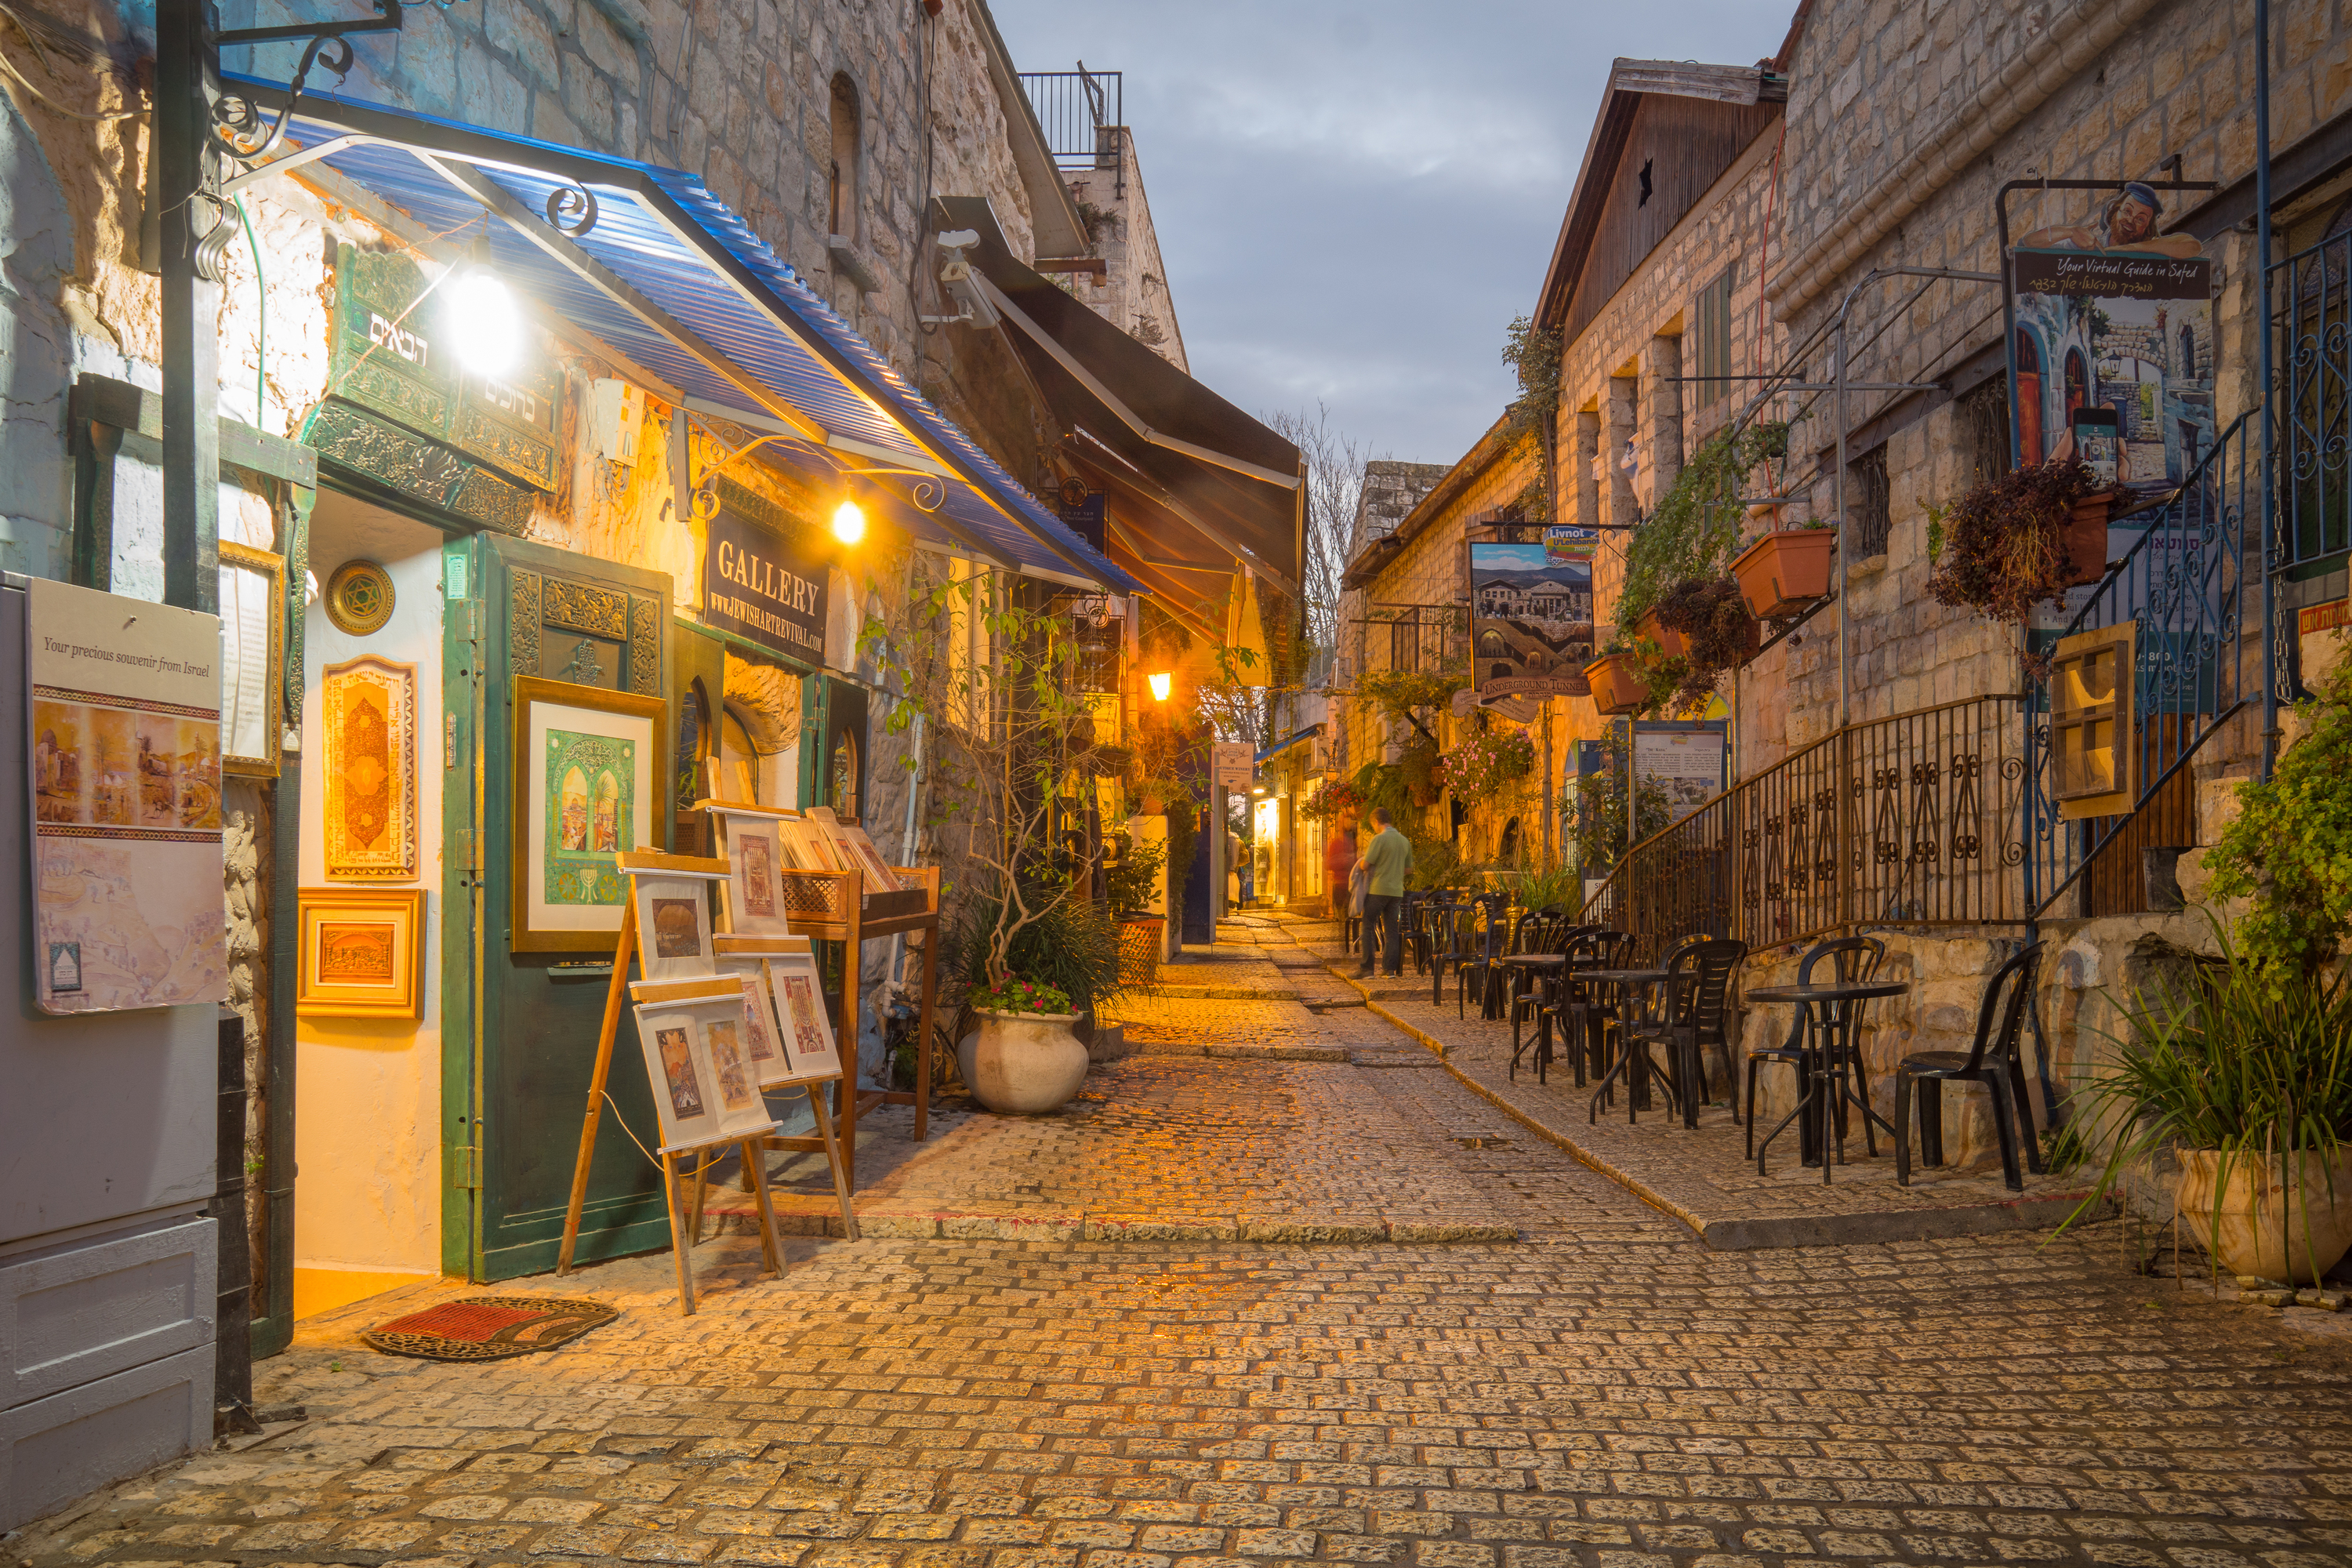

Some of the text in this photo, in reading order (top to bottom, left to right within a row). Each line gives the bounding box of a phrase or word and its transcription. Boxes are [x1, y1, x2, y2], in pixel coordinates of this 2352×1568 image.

[2056, 257, 2199, 285] Your Virtual Guide in Safed
[369, 312, 536, 423] ברוכים הבאים
[1550, 529, 1584, 538] Livnot
[719, 540, 819, 617] GALLERY
[710, 592, 822, 653] WWW.JEWISHARTREVIVAL.COM
[2302, 612, 2318, 632] אש
[44, 637, 210, 677] Your precious souvenir from Israel
[1460, 694, 1478, 702] Partners
[1512, 704, 1526, 714] Center
